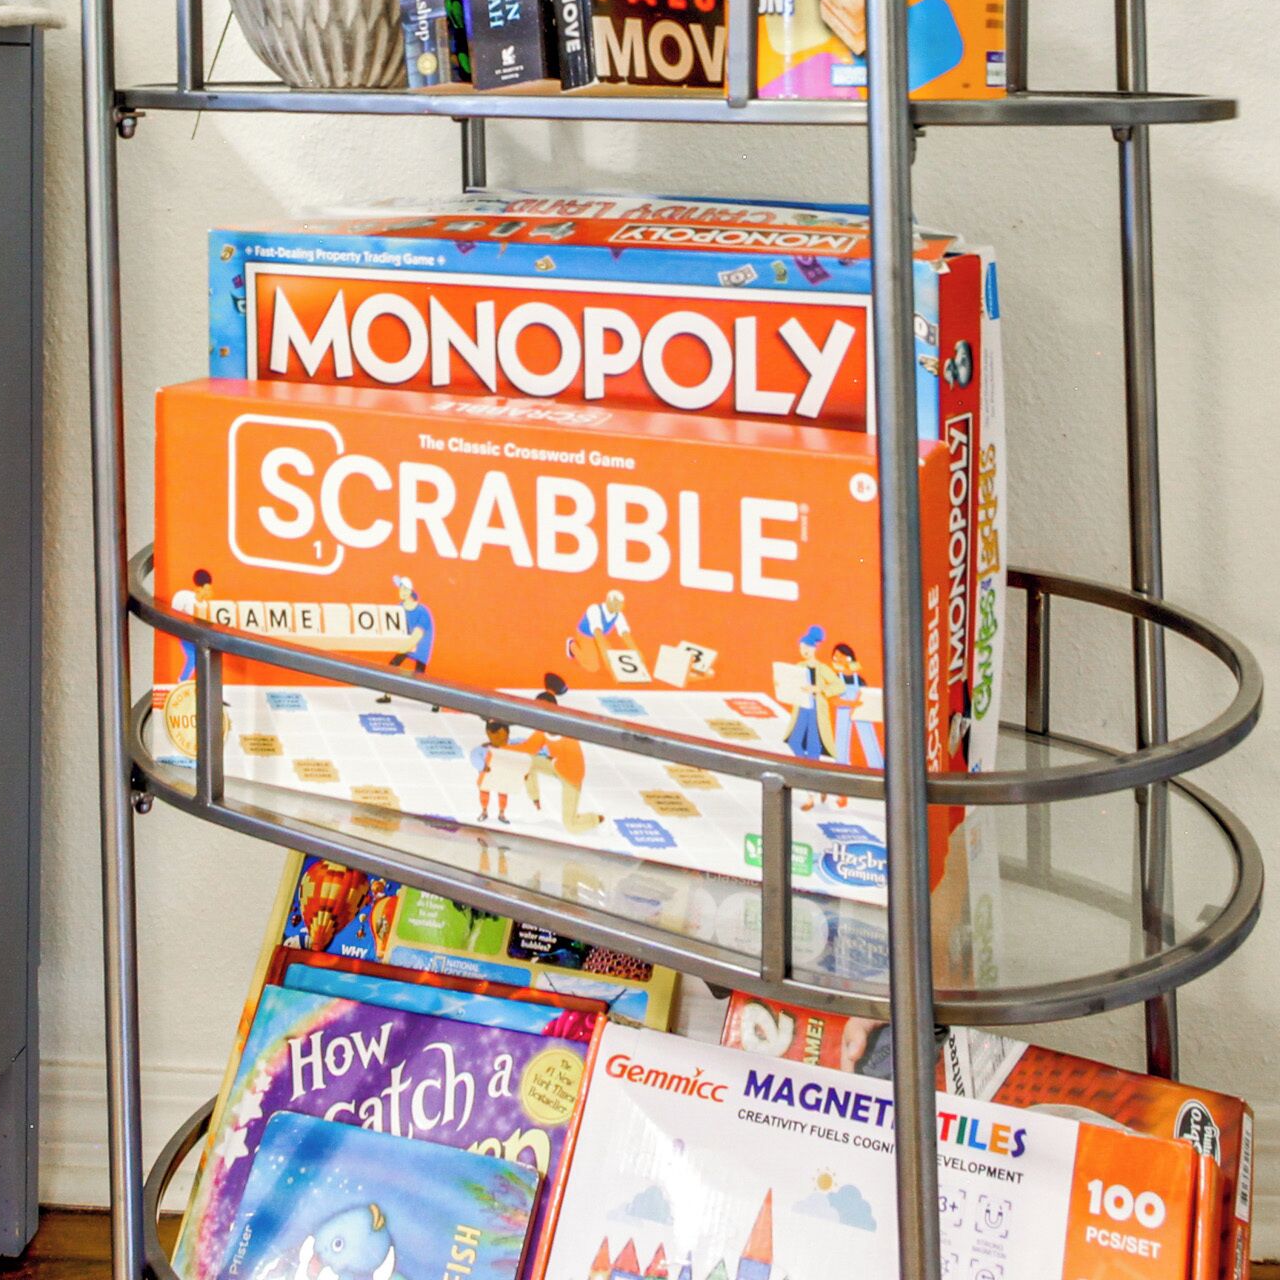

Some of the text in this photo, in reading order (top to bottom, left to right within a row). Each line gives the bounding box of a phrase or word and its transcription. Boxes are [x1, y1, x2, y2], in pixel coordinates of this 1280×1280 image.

[592, 16, 725, 82] MOV
[506, 197, 777, 224] CANDY LAND
[255, 245, 435, 267] Fast-Dealing Property Trading Game
[621, 227, 851, 252] MONOPOLY
[269, 285, 855, 420] MONOPOLY
[419, 433, 636, 470] The Classic Crossword Game
[258, 447, 800, 602] SCRABBLE
[948, 427, 969, 673] MONOPOLY
[216, 607, 401, 631] GAME ON
[169, 714, 196, 729] WOO
[832, 842, 887, 871] Hasbr
[341, 944, 368, 958] WHY
[446, 958, 480, 973] NATIONAL
[521, 939, 552, 952] bubbles?
[288, 1022, 394, 1102] How
[803, 1017, 825, 1066] AME!
[948, 1033, 966, 1098] htzee
[487, 1051, 513, 1098] a
[605, 1054, 729, 1103] Gemmicc
[743, 1069, 1028, 1158] MAGNET TILES
[737, 1108, 1024, 1184] CREATIVITY FUELS COGNI EVELOPMENT
[1087, 1179, 1166, 1229] 100
[229, 1224, 252, 1275] Pfister
[1085, 1226, 1162, 1260] PCS/SET
